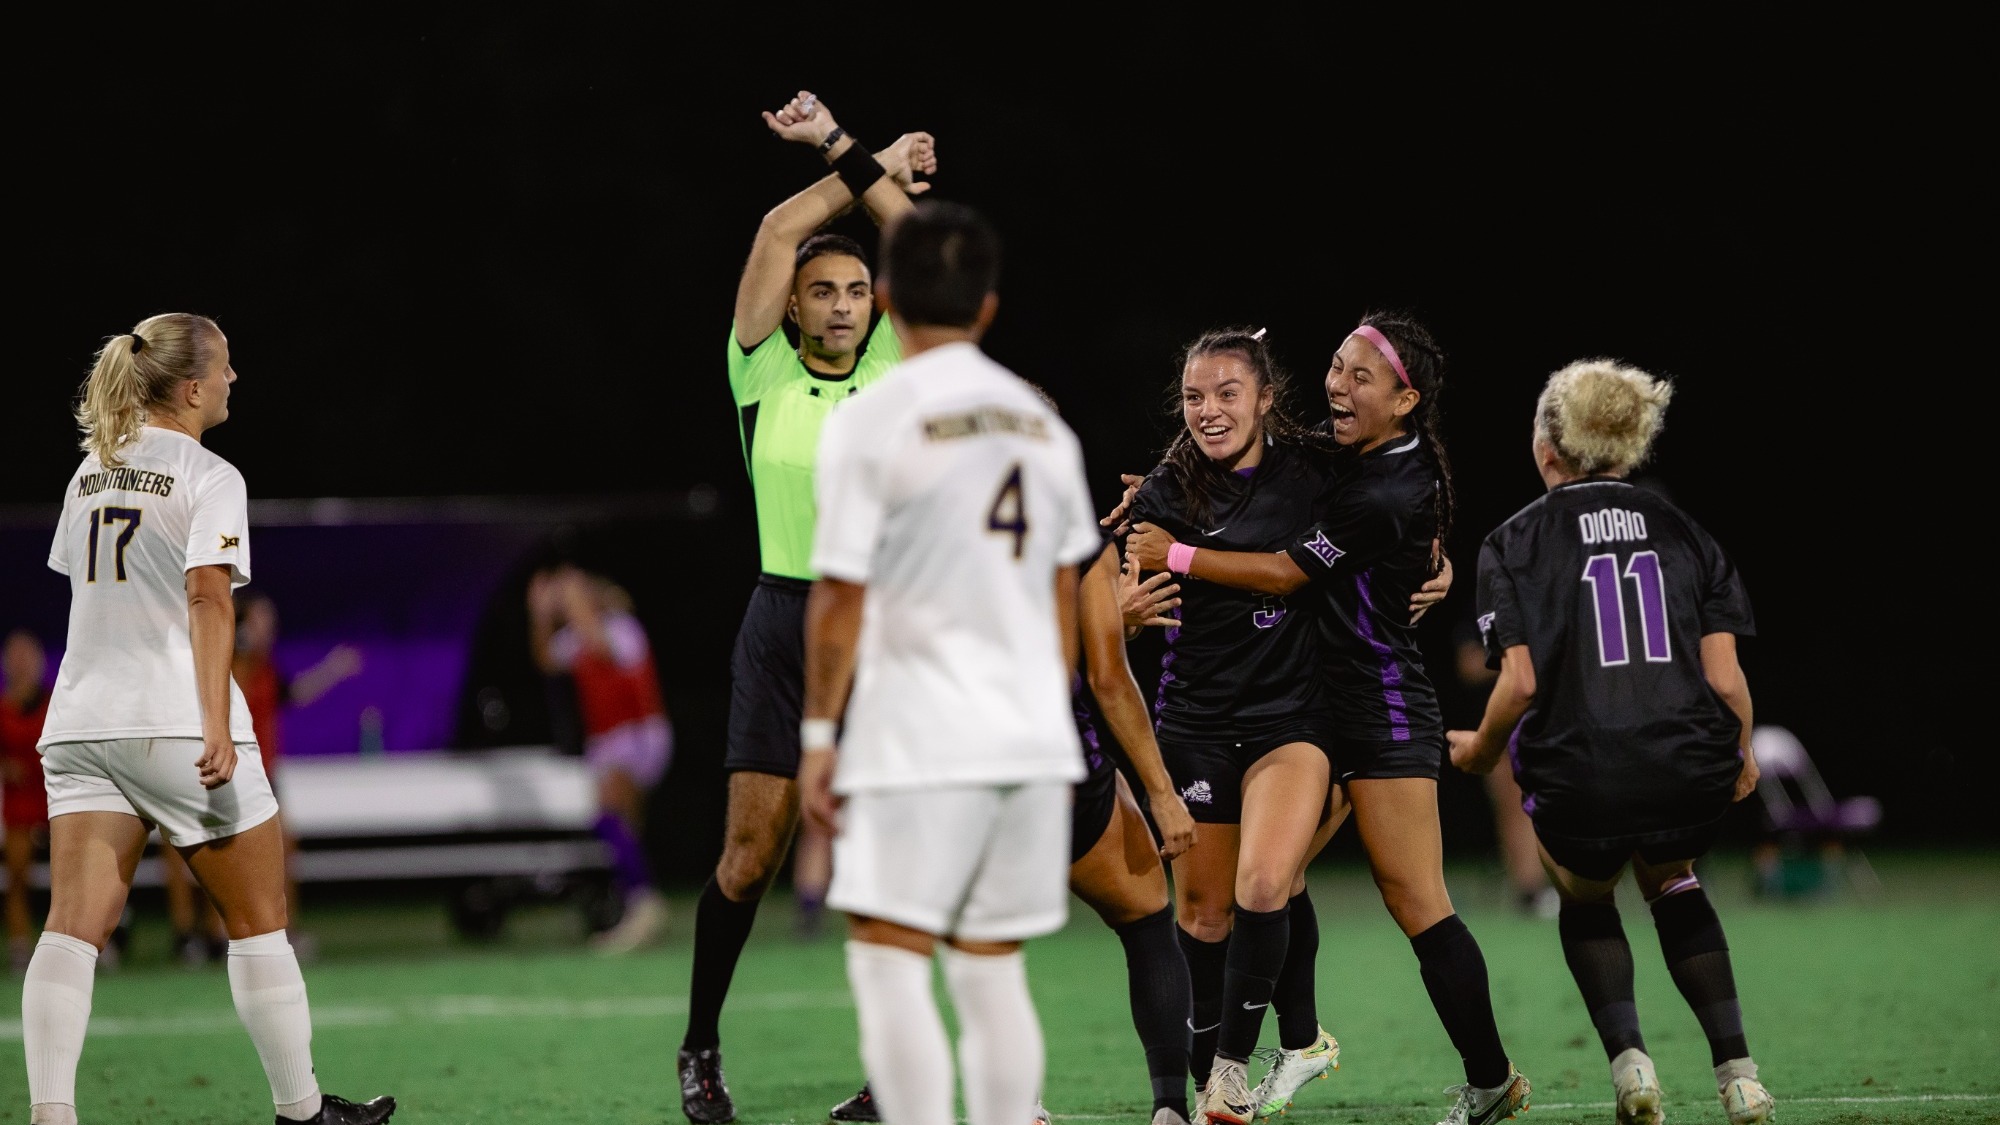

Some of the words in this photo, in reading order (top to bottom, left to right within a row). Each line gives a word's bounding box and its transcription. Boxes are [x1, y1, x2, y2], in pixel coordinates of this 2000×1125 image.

[77, 467, 174, 498] MOUNTAINEERS
[986, 462, 1030, 559] 4
[86, 506, 143, 584] 17
[1303, 530, 1346, 568] XII
[1579, 508, 1648, 544] DIORIO
[1581, 550, 1672, 667] 11
